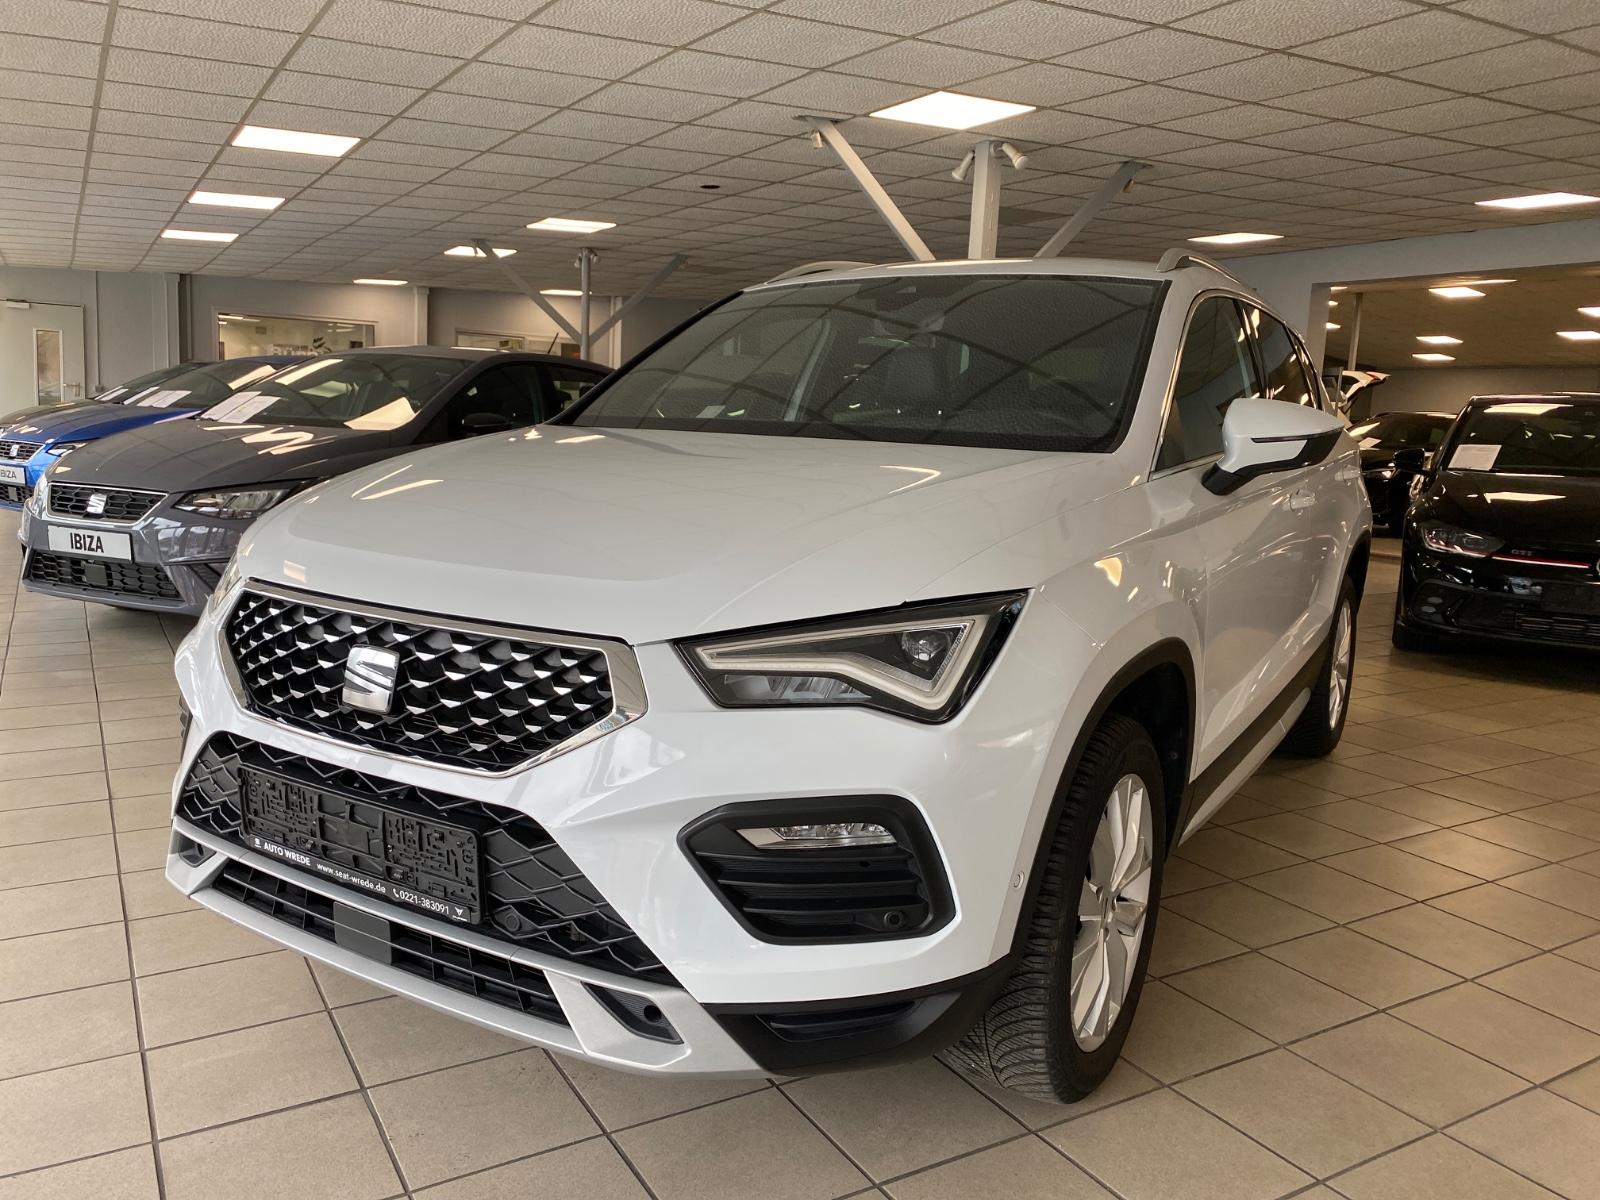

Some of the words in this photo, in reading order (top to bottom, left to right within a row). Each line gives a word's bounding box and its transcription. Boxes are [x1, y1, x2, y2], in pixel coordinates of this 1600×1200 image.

[0, 469, 16, 479] BIZA
[70, 532, 104, 553] IBIZA
[264, 842, 284, 856] AUTO
[284, 849, 311, 866] WREDE
[316, 863, 386, 893] www.seat-wrede.de
[399, 890, 449, 915] 0221-383091
